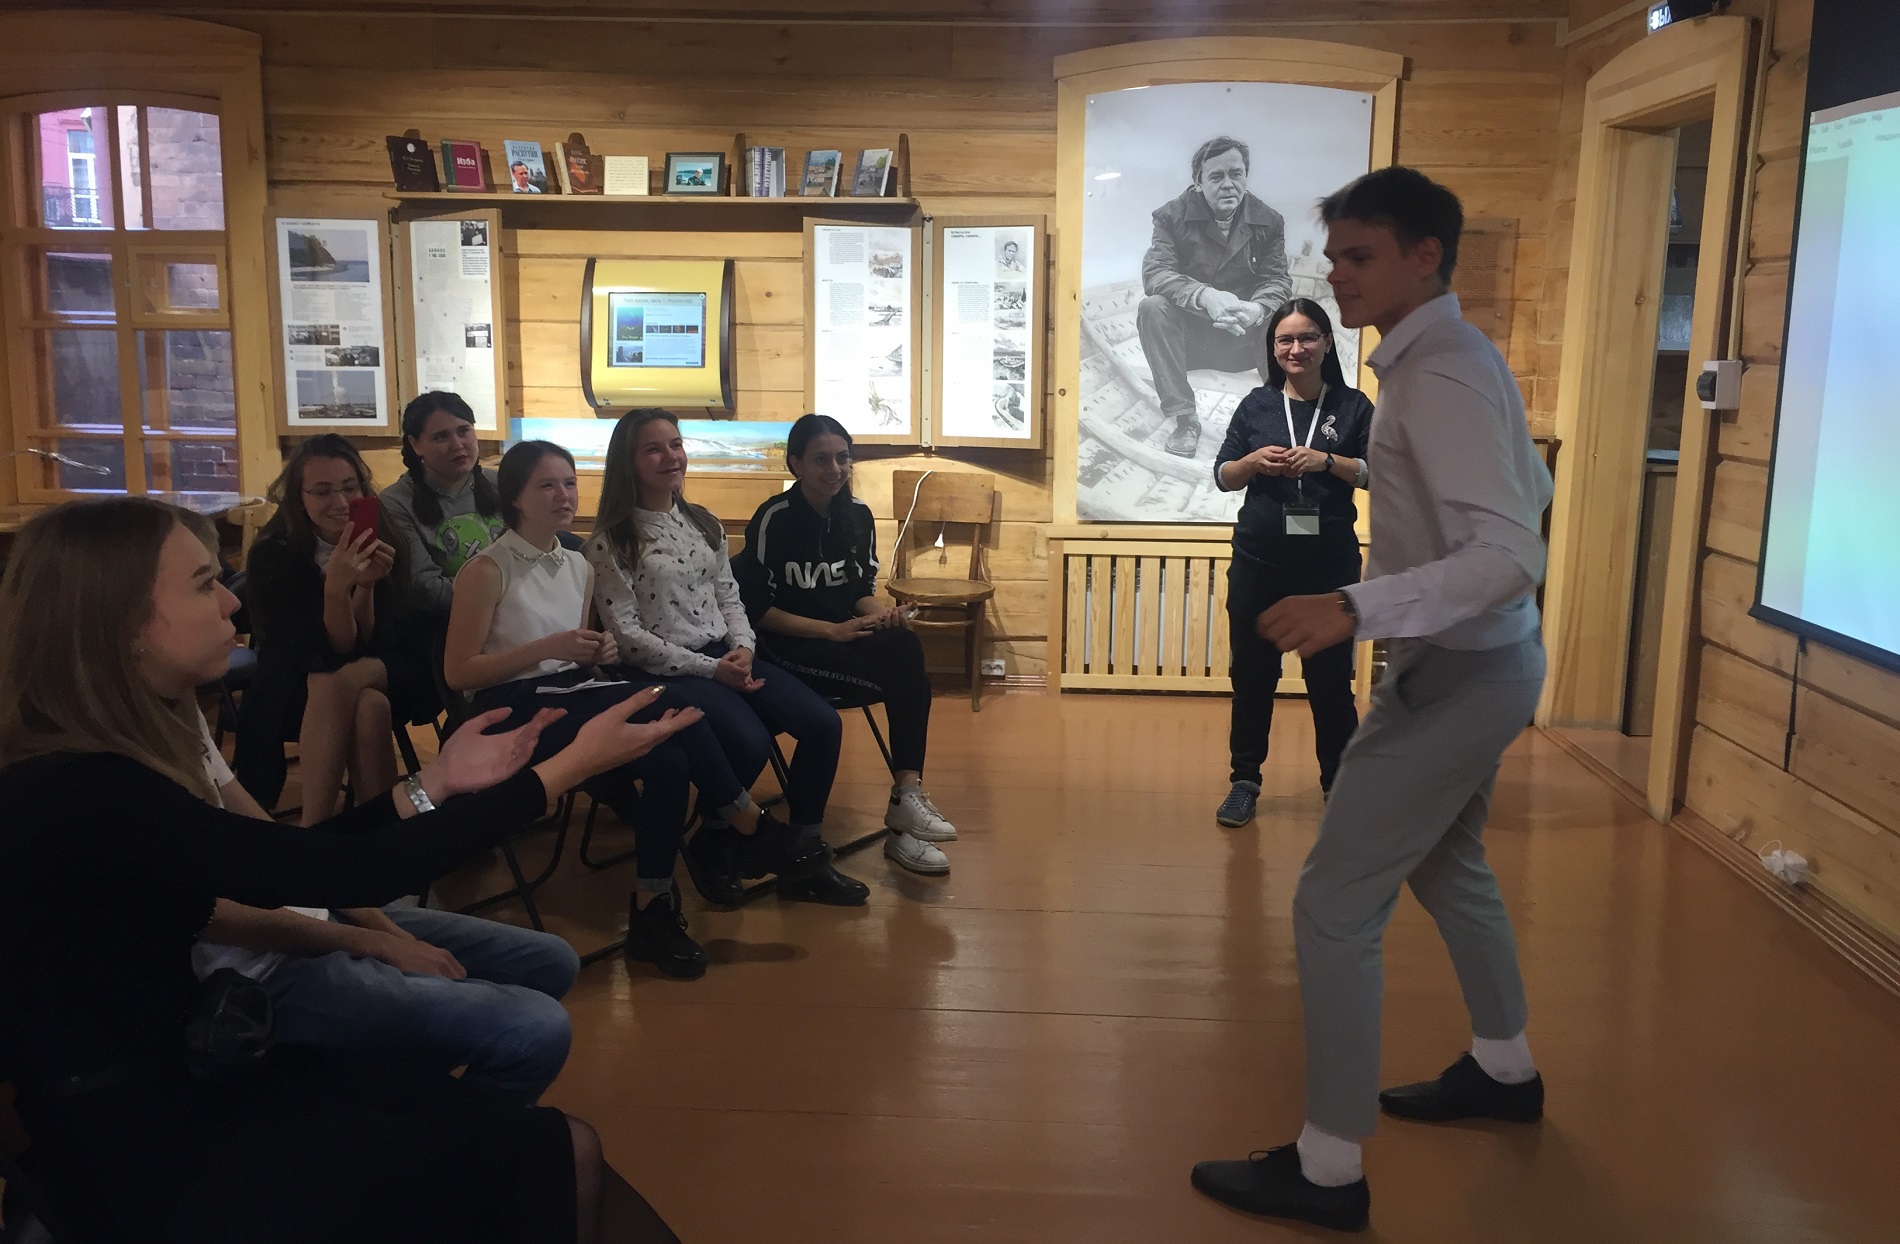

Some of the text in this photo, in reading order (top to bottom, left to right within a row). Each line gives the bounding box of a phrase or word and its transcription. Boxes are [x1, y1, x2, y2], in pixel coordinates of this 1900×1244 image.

[1650, 6, 1672, 30] ВЫХ
[456, 157, 476, 166] Изба
[784, 559, 864, 589] NAS
